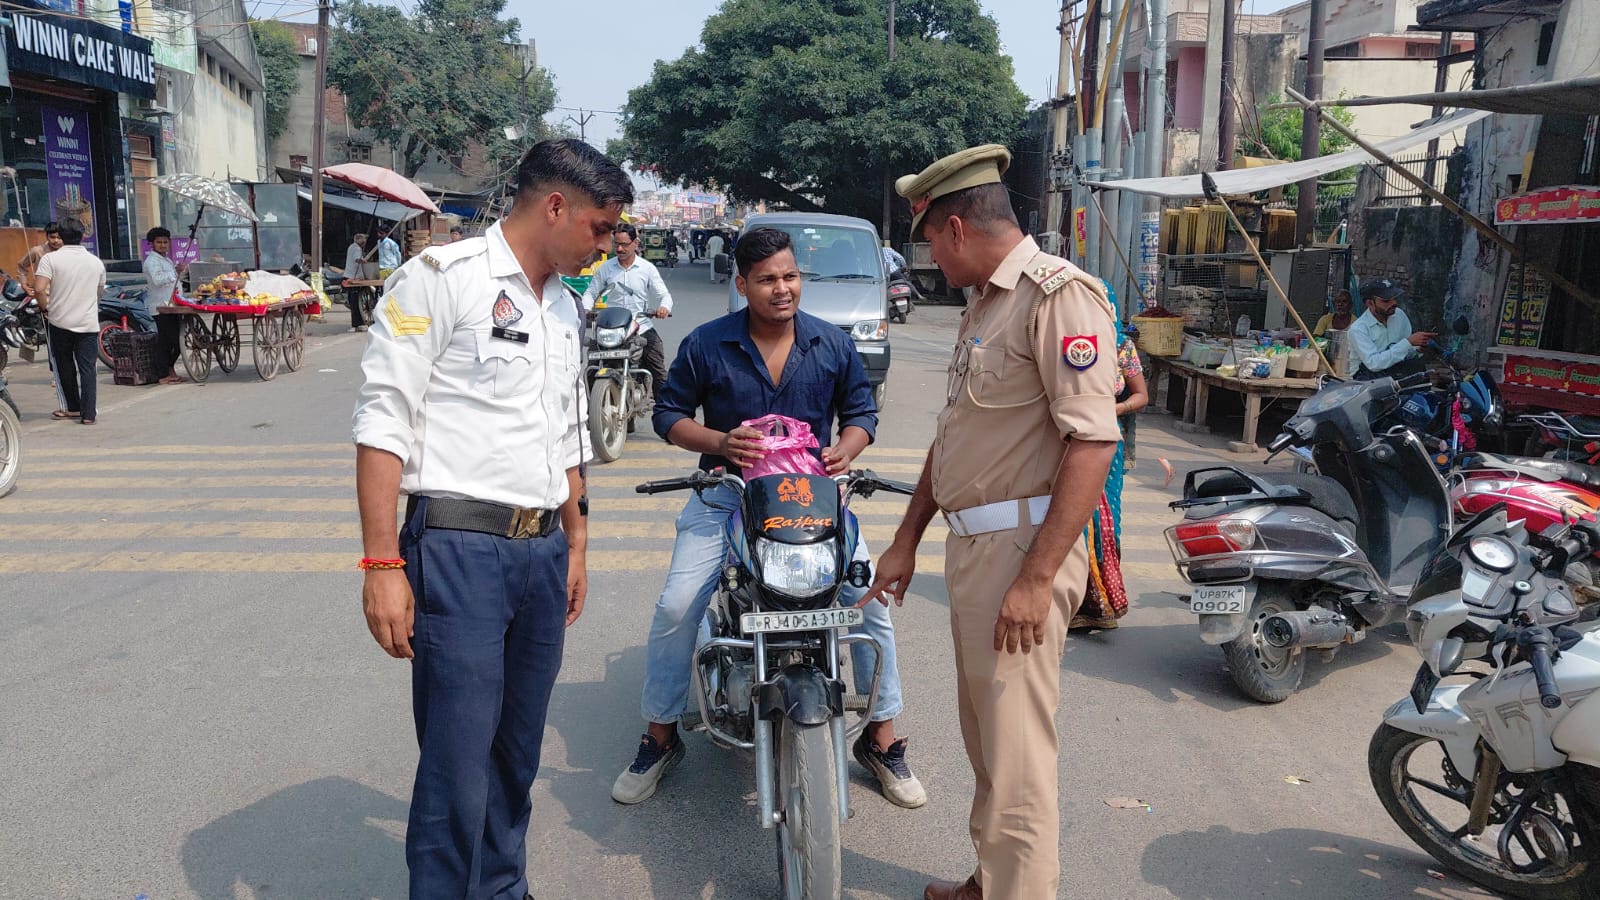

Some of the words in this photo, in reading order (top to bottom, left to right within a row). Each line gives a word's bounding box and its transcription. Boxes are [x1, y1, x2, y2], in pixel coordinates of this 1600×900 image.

[12, 13, 70, 62] WINNI
[73, 33, 115, 74] CAKE
[118, 46, 156, 85] WALE
[56, 136, 79, 150] WINNI
[1199, 590, 1236, 600] UP87K
[1193, 601, 1241, 612] 0902
